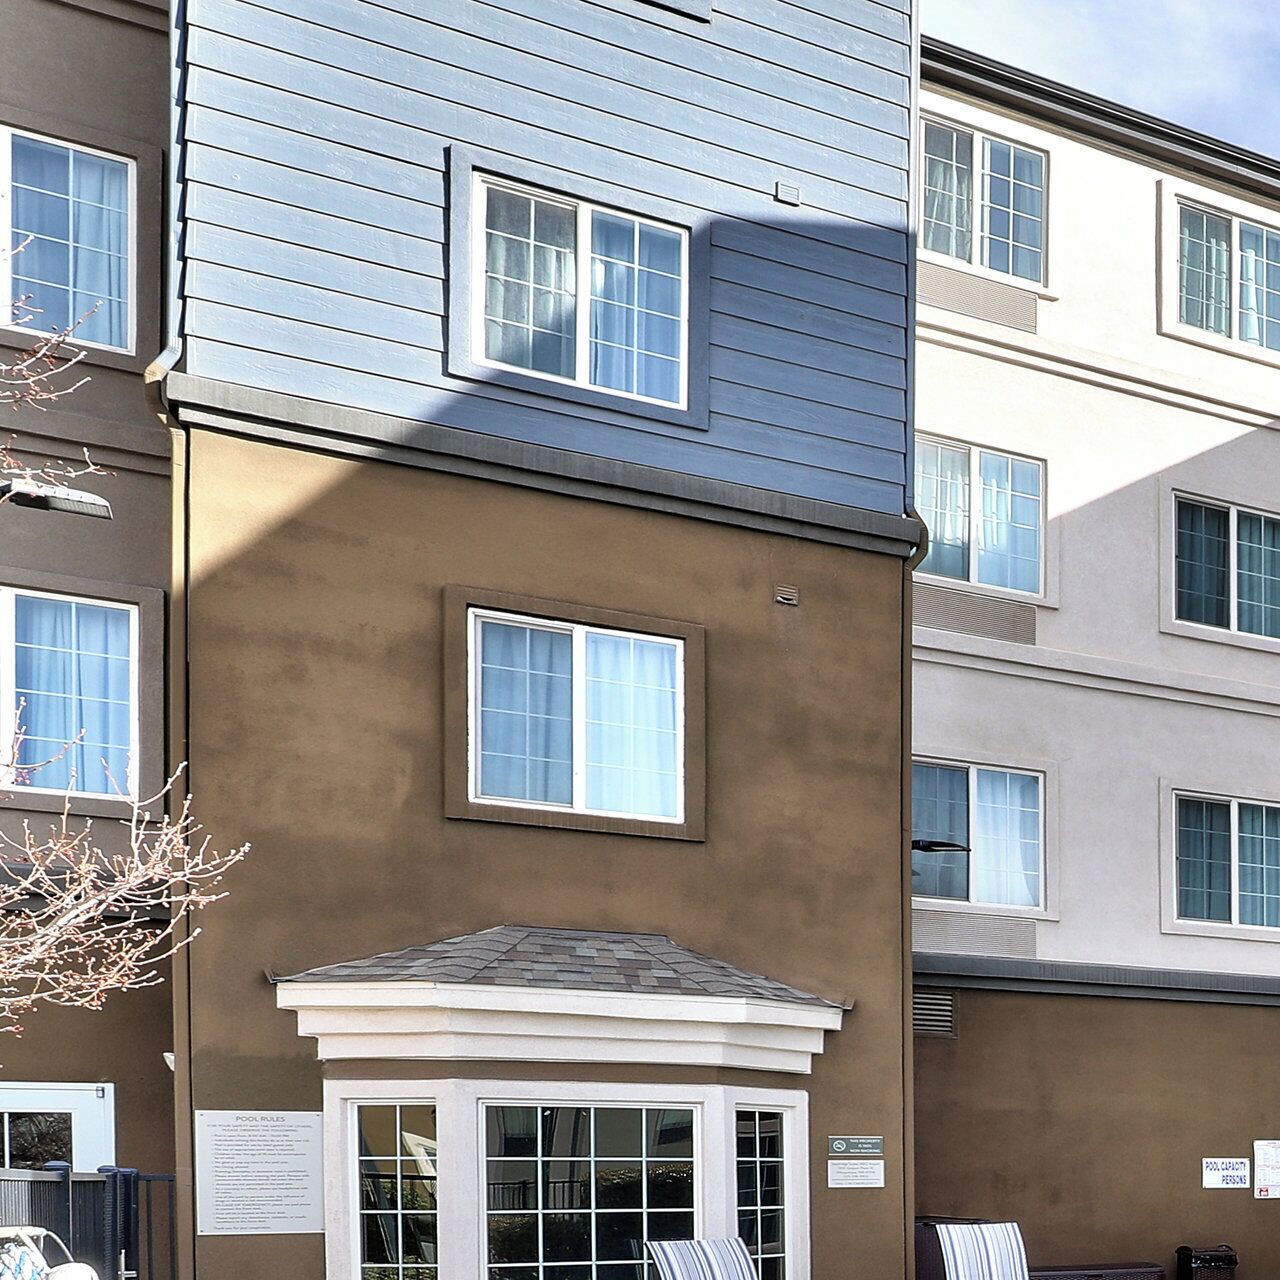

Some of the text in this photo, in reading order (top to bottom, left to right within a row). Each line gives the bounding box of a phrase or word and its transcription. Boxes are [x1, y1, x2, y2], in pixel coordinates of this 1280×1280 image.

[1205, 1161, 1246, 1171] POOL CAPACITY
[1221, 1174, 1247, 1185] PERSONS
